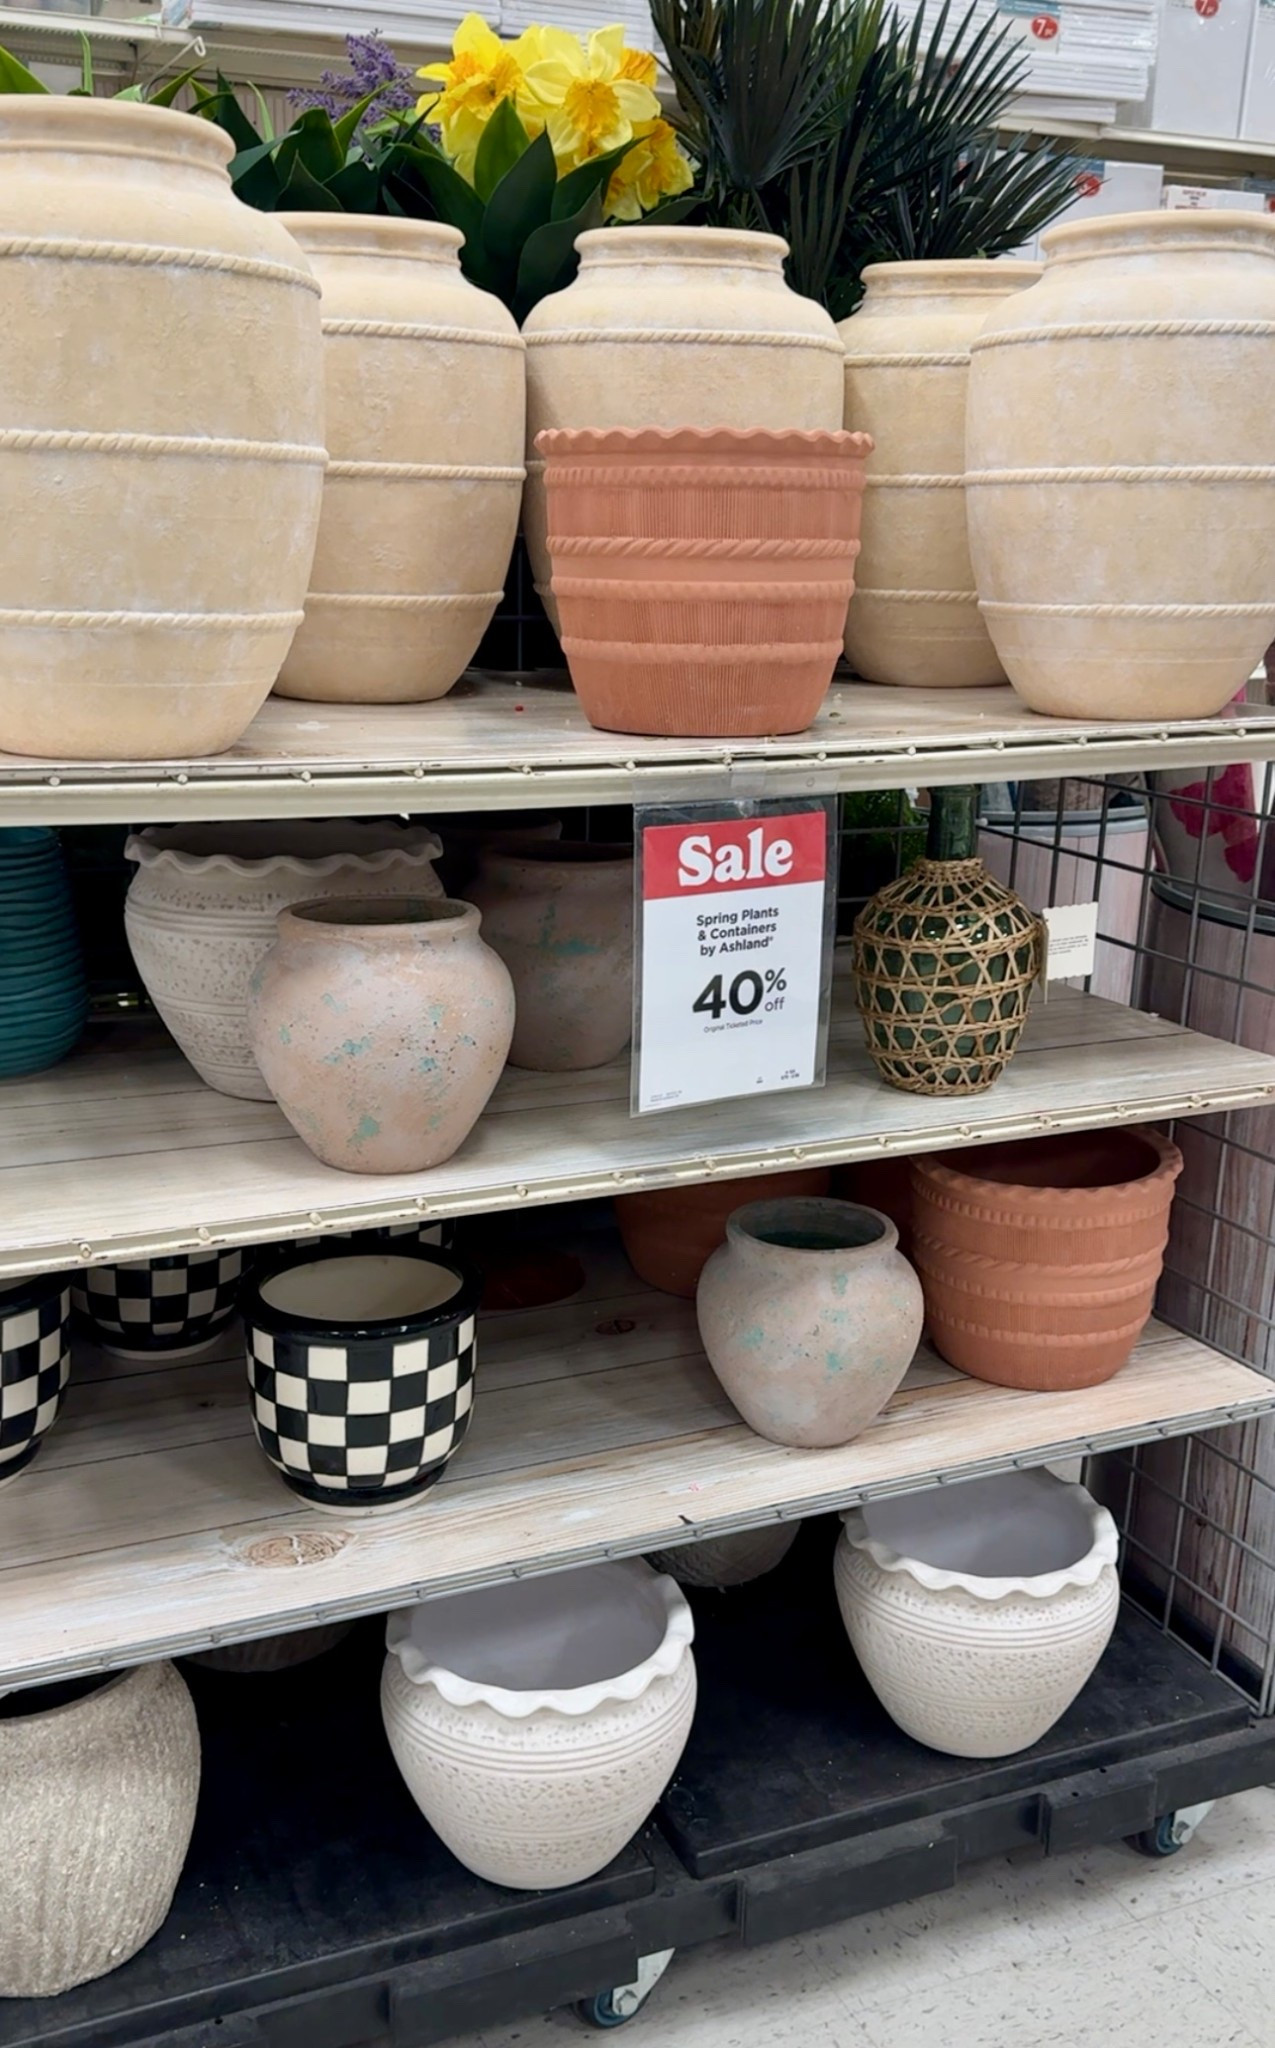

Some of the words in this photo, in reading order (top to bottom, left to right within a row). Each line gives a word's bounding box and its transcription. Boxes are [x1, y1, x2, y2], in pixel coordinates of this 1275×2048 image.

[1036, 18, 1047, 36] 7
[678, 828, 793, 886] Sale
[696, 912, 738, 928] Spring
[741, 907, 780, 921] Plants
[697, 929, 707, 942] &
[710, 922, 777, 940] Containers
[699, 945, 716, 957] by
[764, 996, 785, 1012] off
[726, 1021, 749, 1030] Ticketed
[749, 1018, 764, 1027] Price
